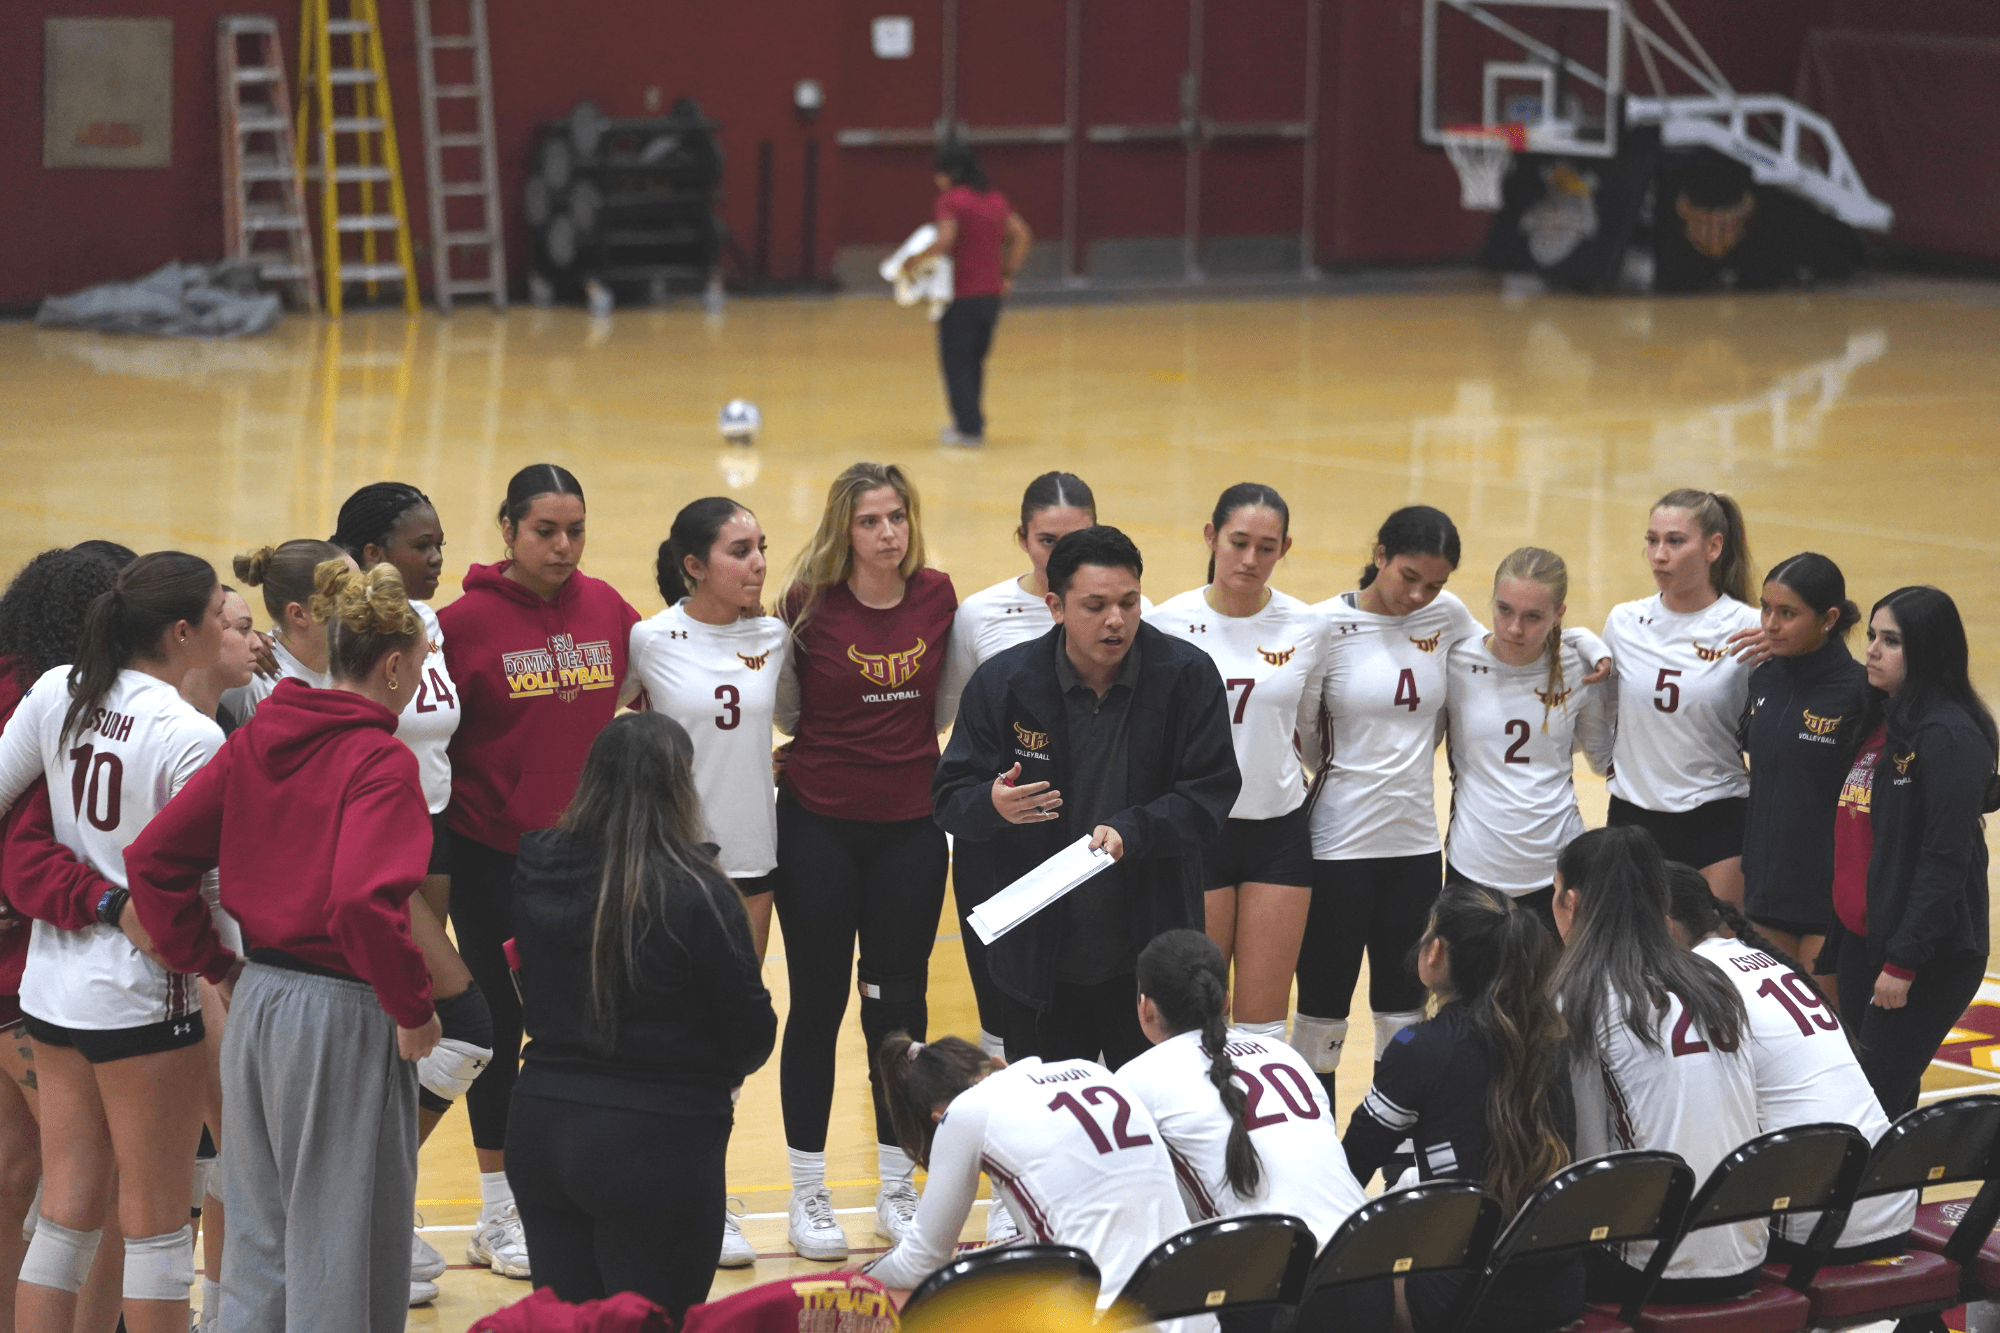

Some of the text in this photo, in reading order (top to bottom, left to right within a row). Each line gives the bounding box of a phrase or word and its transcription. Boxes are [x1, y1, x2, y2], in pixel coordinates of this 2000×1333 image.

[507, 664, 615, 692] VOLLEYBALL
[584, 647, 613, 667] HILLS
[847, 638, 926, 689] DH
[416, 668, 455, 713] 24
[715, 685, 740, 730] 3
[862, 690, 921, 703] VOLLEYBALL
[1226, 678, 1255, 724] 7
[1394, 668, 1420, 712] 4
[1654, 668, 1682, 713] 5
[1014, 748, 1050, 761] VOLLEYBALL
[1504, 719, 1530, 763] 2
[1799, 732, 1836, 745] VOLLEYBALL
[70, 743, 123, 832] 10
[1756, 972, 1839, 1037] 19
[1208, 1063, 1321, 1131] 20
[1047, 1086, 1153, 1154] 12
